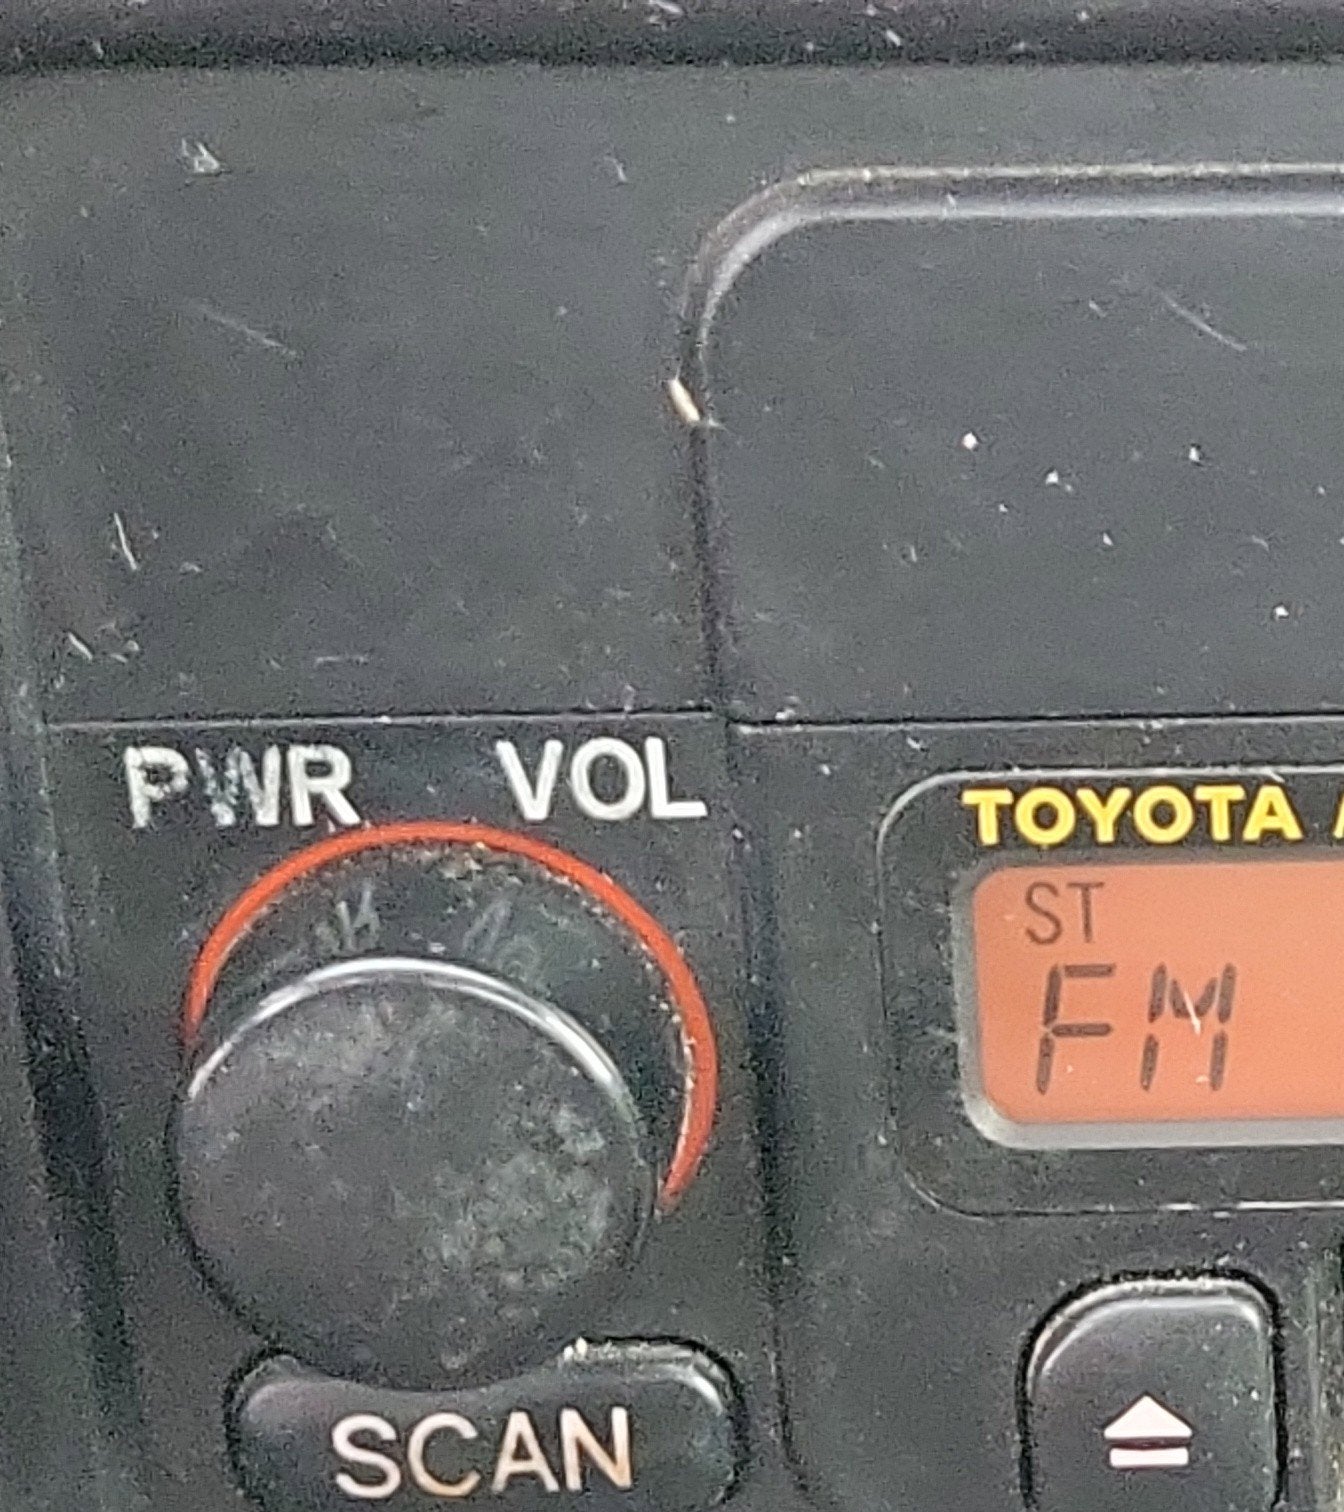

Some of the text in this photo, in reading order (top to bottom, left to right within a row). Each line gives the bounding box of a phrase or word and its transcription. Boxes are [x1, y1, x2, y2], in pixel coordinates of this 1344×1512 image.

[123, 745, 361, 828] PWR
[496, 736, 708, 821] VOL
[962, 786, 1303, 845] TOYOTA
[1025, 881, 1105, 944] ST
[1036, 962, 1236, 1094] FM
[331, 1406, 635, 1499] SCAN
